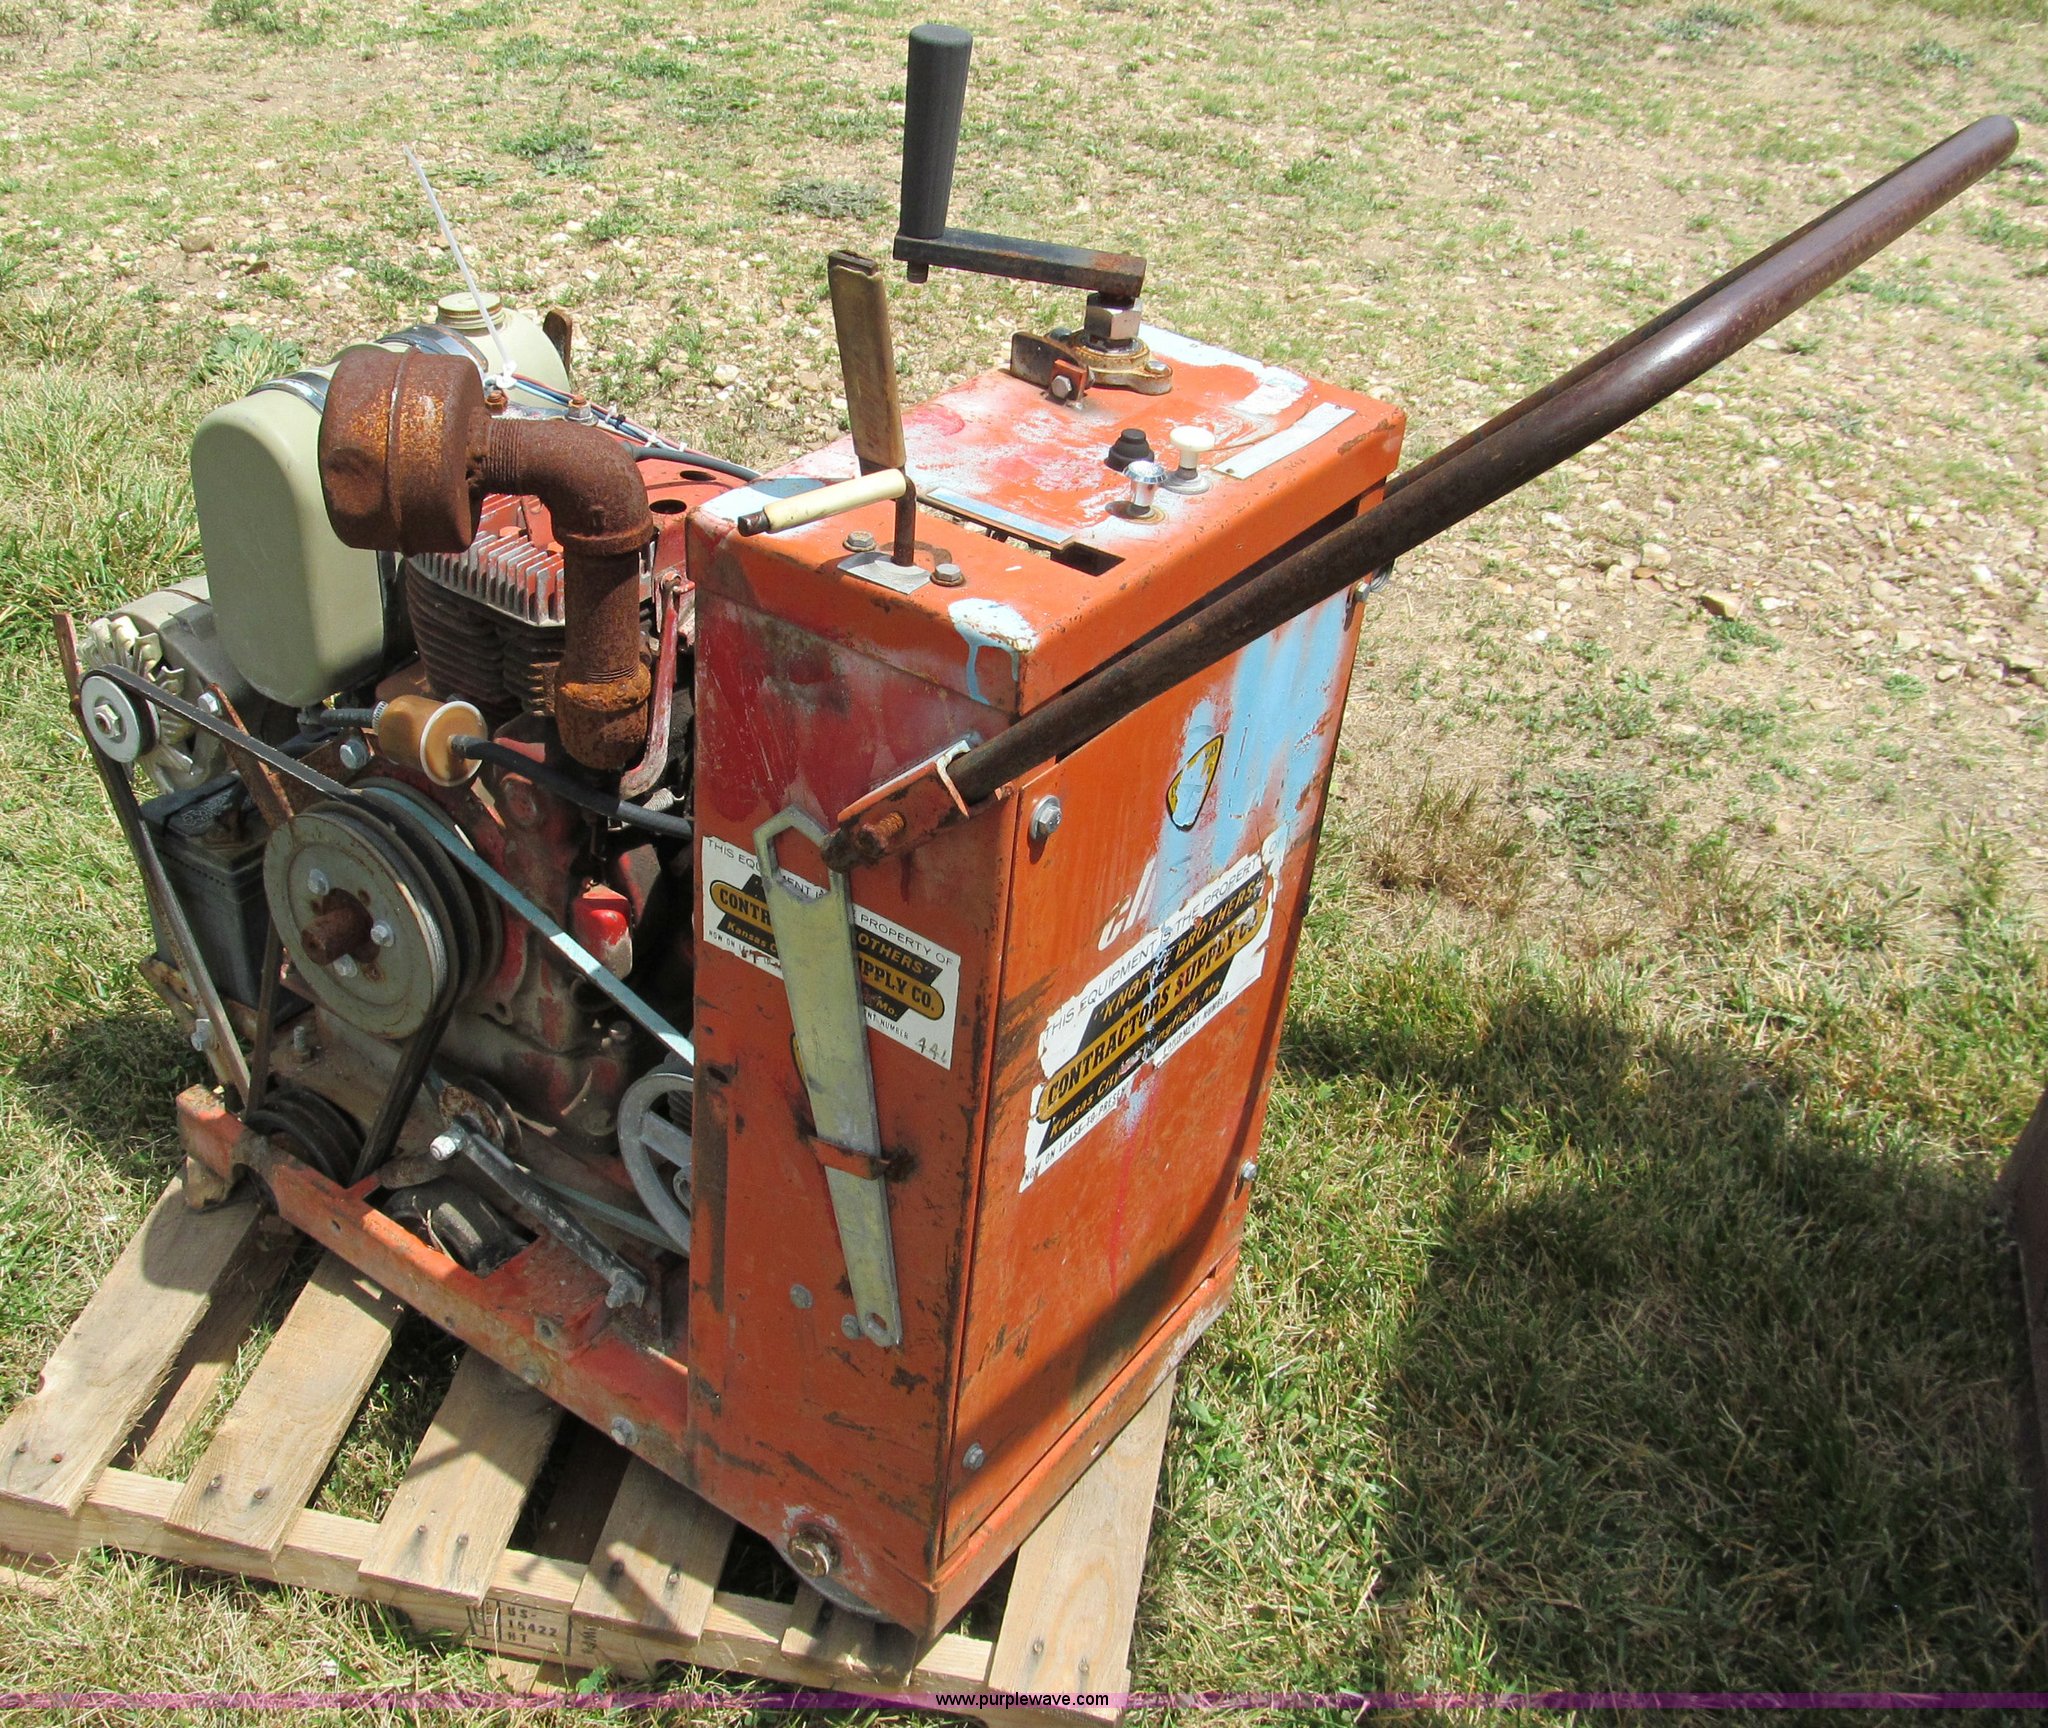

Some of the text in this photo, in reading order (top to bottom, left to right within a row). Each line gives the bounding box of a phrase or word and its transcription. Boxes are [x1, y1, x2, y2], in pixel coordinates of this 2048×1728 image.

[707, 839, 735, 860] THIS
[860, 913, 932, 957] PROPERTY
[935, 952, 954, 966] OF
[727, 921, 767, 948] Kansas
[1045, 1008, 1075, 1040] THIS
[1078, 938, 1157, 1015] EQUIPMENT
[1175, 904, 1200, 934] THE
[1203, 855, 1261, 910] PROPERT
[861, 958, 907, 995] PPLY
[911, 985, 934, 1012] CO.
[881, 1019, 909, 1040] NUMBER
[1047, 983, 1170, 1107] CONTRACTORS
[1174, 929, 1235, 996] SUPPLY
[1050, 1093, 1094, 1139] Kansas
[1045, 1148, 1056, 1165] ON
